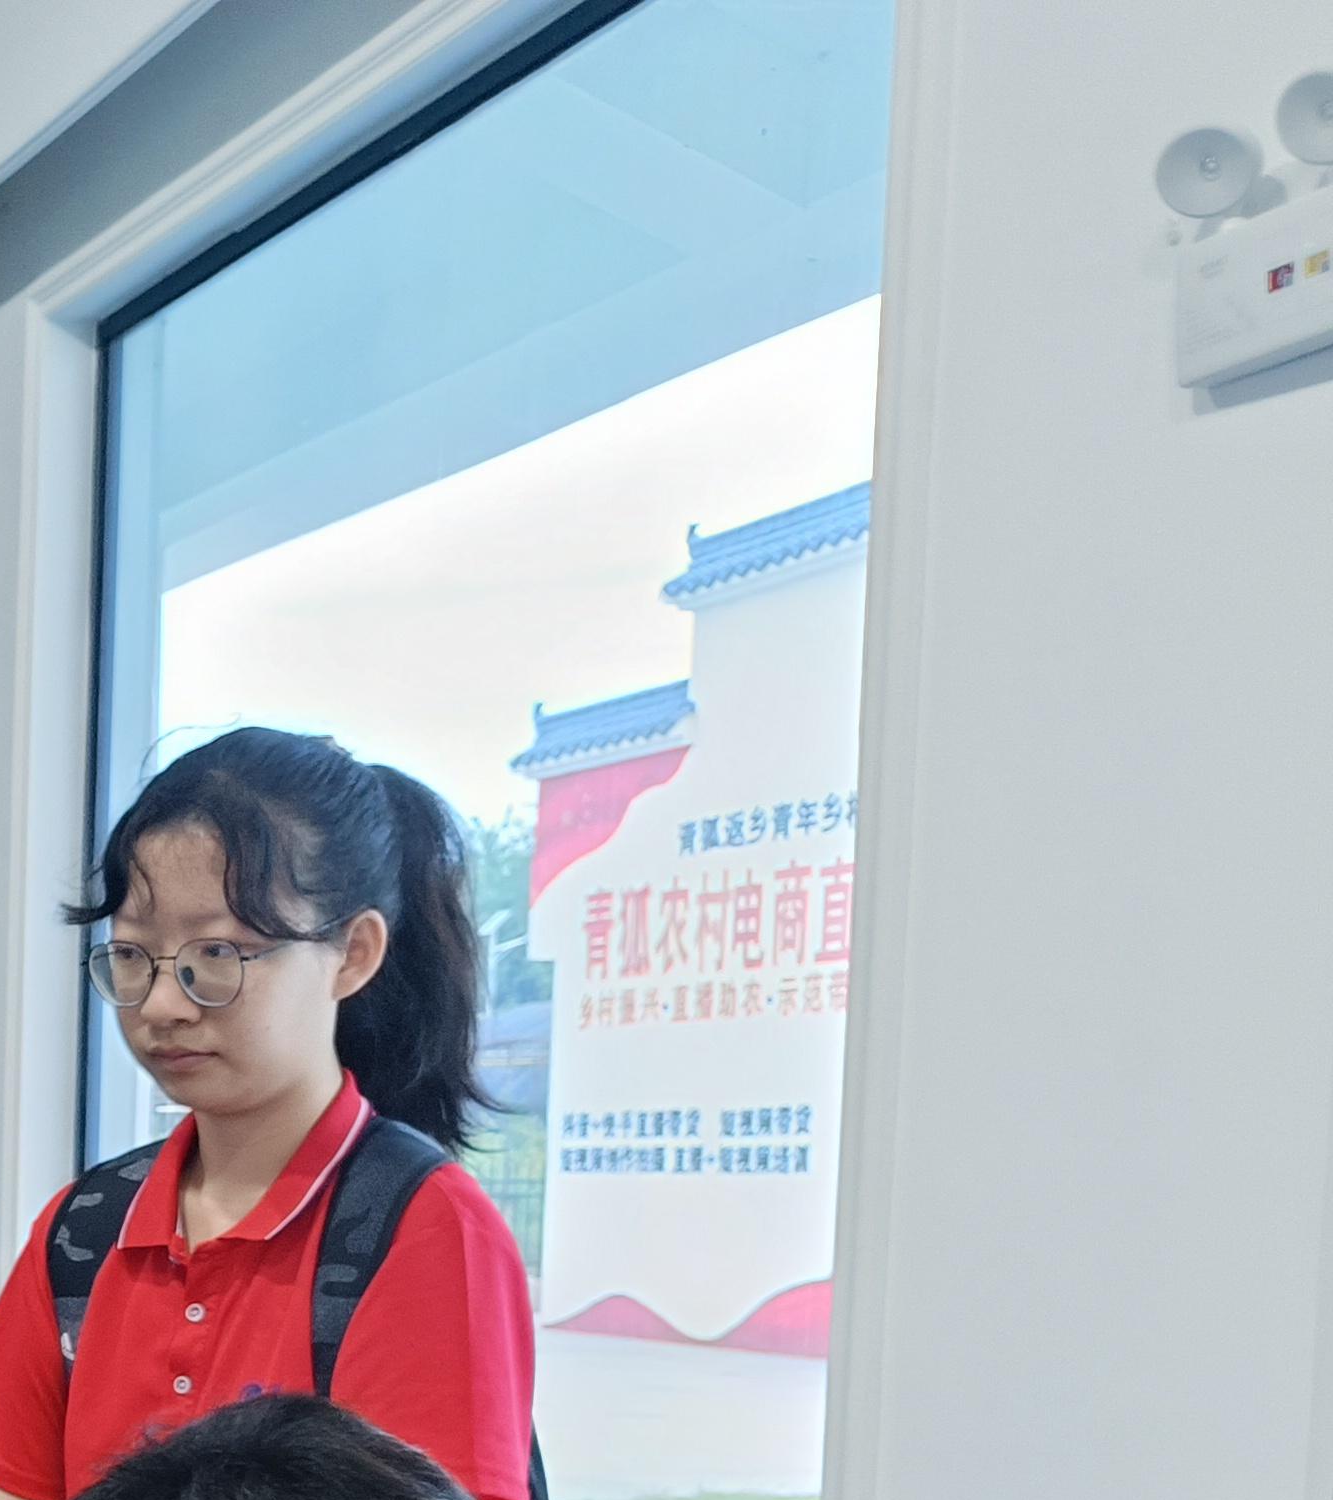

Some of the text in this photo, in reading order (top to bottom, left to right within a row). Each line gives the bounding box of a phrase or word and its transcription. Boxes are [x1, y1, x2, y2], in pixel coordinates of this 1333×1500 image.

[583, 857, 853, 981] 青狐农村电商直
